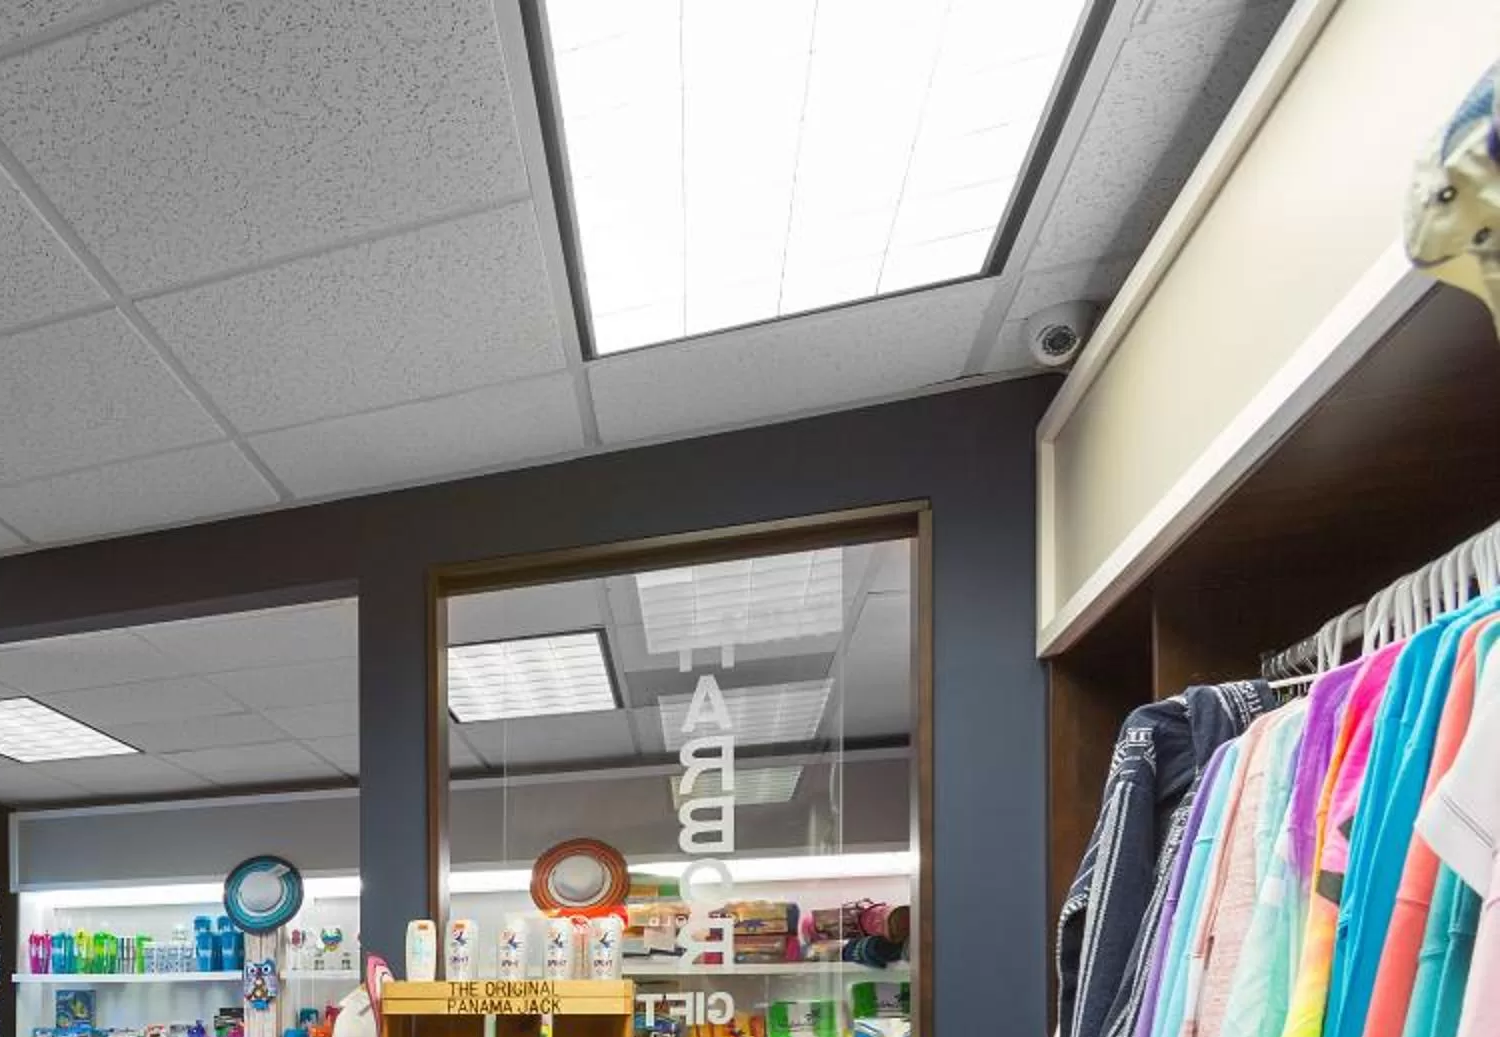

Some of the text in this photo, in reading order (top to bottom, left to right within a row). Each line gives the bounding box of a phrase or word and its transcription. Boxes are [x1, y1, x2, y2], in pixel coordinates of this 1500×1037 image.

[447, 980, 558, 997] THE ORIGINAL
[447, 997, 562, 1015] PANAMA JACK
